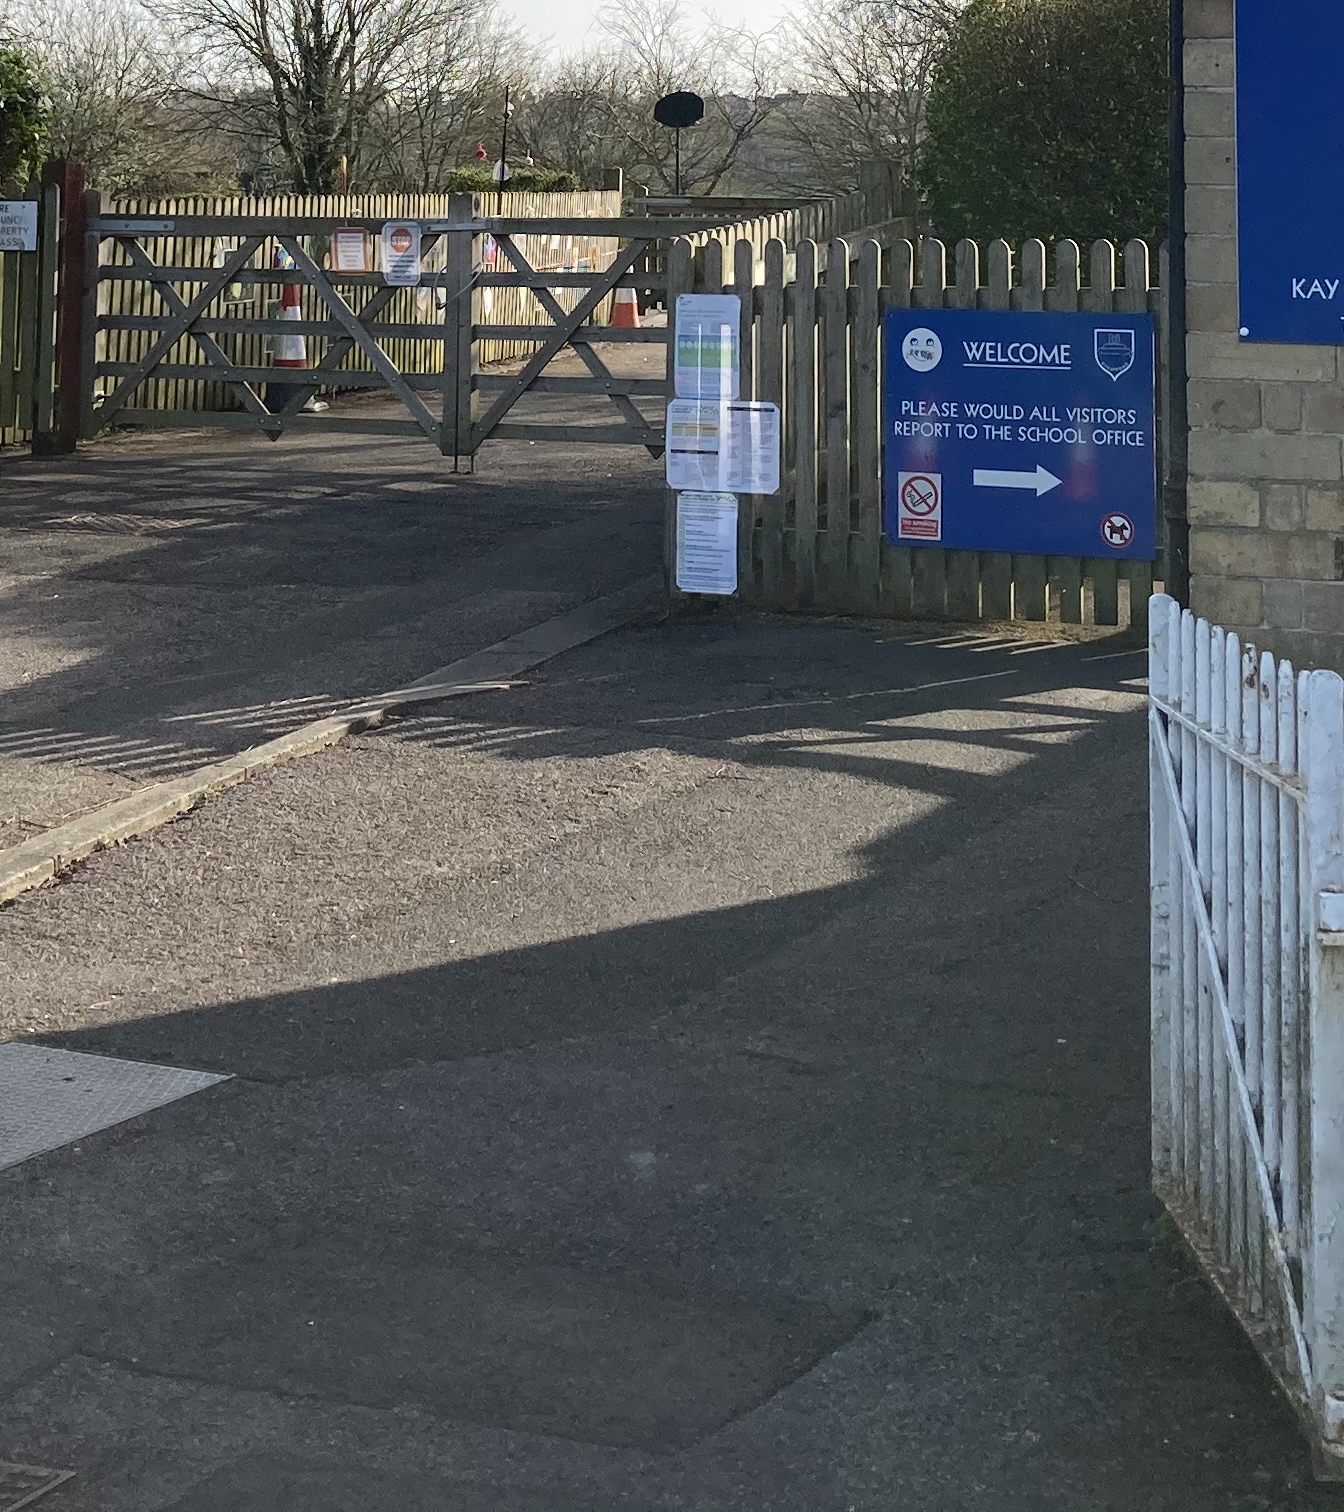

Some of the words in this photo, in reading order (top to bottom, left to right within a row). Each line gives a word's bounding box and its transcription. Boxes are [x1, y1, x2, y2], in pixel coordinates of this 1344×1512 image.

[1291, 277, 1340, 300] KAY
[962, 341, 1072, 365] WELCOME
[901, 400, 959, 418] PLEASE
[963, 402, 1025, 421] WOULD
[1028, 405, 1062, 422] ALL
[1065, 406, 1137, 425] VISITORS
[893, 420, 952, 438] REPORT
[955, 423, 978, 440] TO
[982, 424, 1013, 441] THE
[1017, 426, 1088, 445] SCHOOL
[1091, 429, 1145, 447] OFFICE
